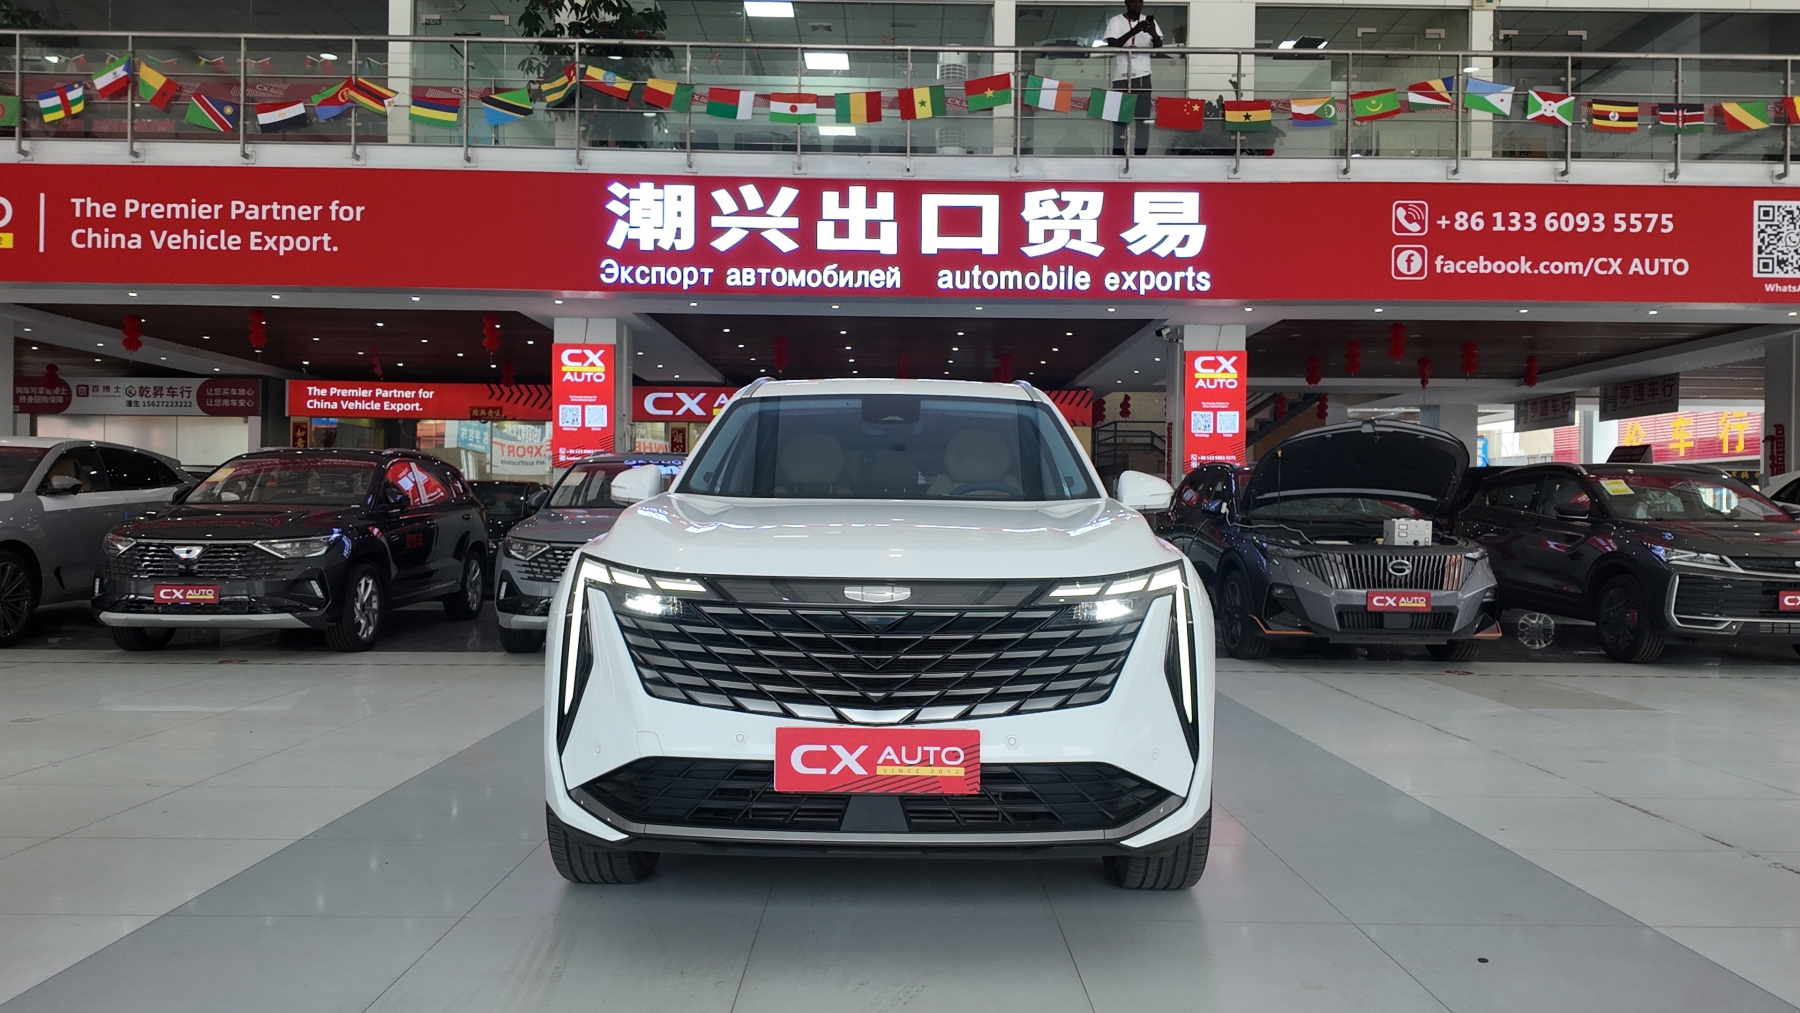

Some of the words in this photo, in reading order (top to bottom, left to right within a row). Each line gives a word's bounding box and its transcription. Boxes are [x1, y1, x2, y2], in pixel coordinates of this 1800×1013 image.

[947, 98, 961, 106] CX
[70, 197, 117, 218] The
[124, 199, 224, 220] Premier
[230, 200, 323, 221] Partner
[328, 200, 366, 222] for
[604, 181, 1208, 258] 潮兴出口贸易
[1436, 211, 1485, 232] +86
[1492, 212, 1537, 232] 133
[1544, 212, 1606, 233] 6093
[1613, 213, 1674, 234] 5575
[71, 228, 142, 250] China
[149, 229, 242, 251] Vehicle
[249, 231, 339, 256] Export.
[599, 259, 714, 290] Экспорт
[725, 262, 901, 289] автомобилей
[1435, 255, 1623, 277] facebook.com/CX
[1628, 257, 1690, 276] AUTO
[937, 264, 1091, 292] automobile
[1104, 266, 1212, 297] exports
[560, 348, 605, 367] CX
[1194, 355, 1238, 374] CX
[562, 371, 606, 383] AUTO
[1194, 378, 1239, 389] AUTO
[205, 387, 255, 397] 让您买车放心
[306, 386, 328, 397] The
[329, 387, 374, 398] Premier
[375, 388, 417, 399] Partner
[418, 389, 435, 399] for
[1619, 377, 1676, 404] 亨通车行
[205, 398, 255, 408] 让您用车安心
[306, 398, 338, 410] China
[340, 399, 382, 411] Vehicle
[383, 401, 423, 413] Export.
[643, 392, 707, 416] CX
[1528, 395, 1572, 419] 亨通车行
[159, 588, 184, 599] CX
[186, 588, 215, 596] AUTO
[1372, 595, 1397, 607] CX
[790, 744, 869, 775] CX
[876, 745, 965, 765] AUTO
